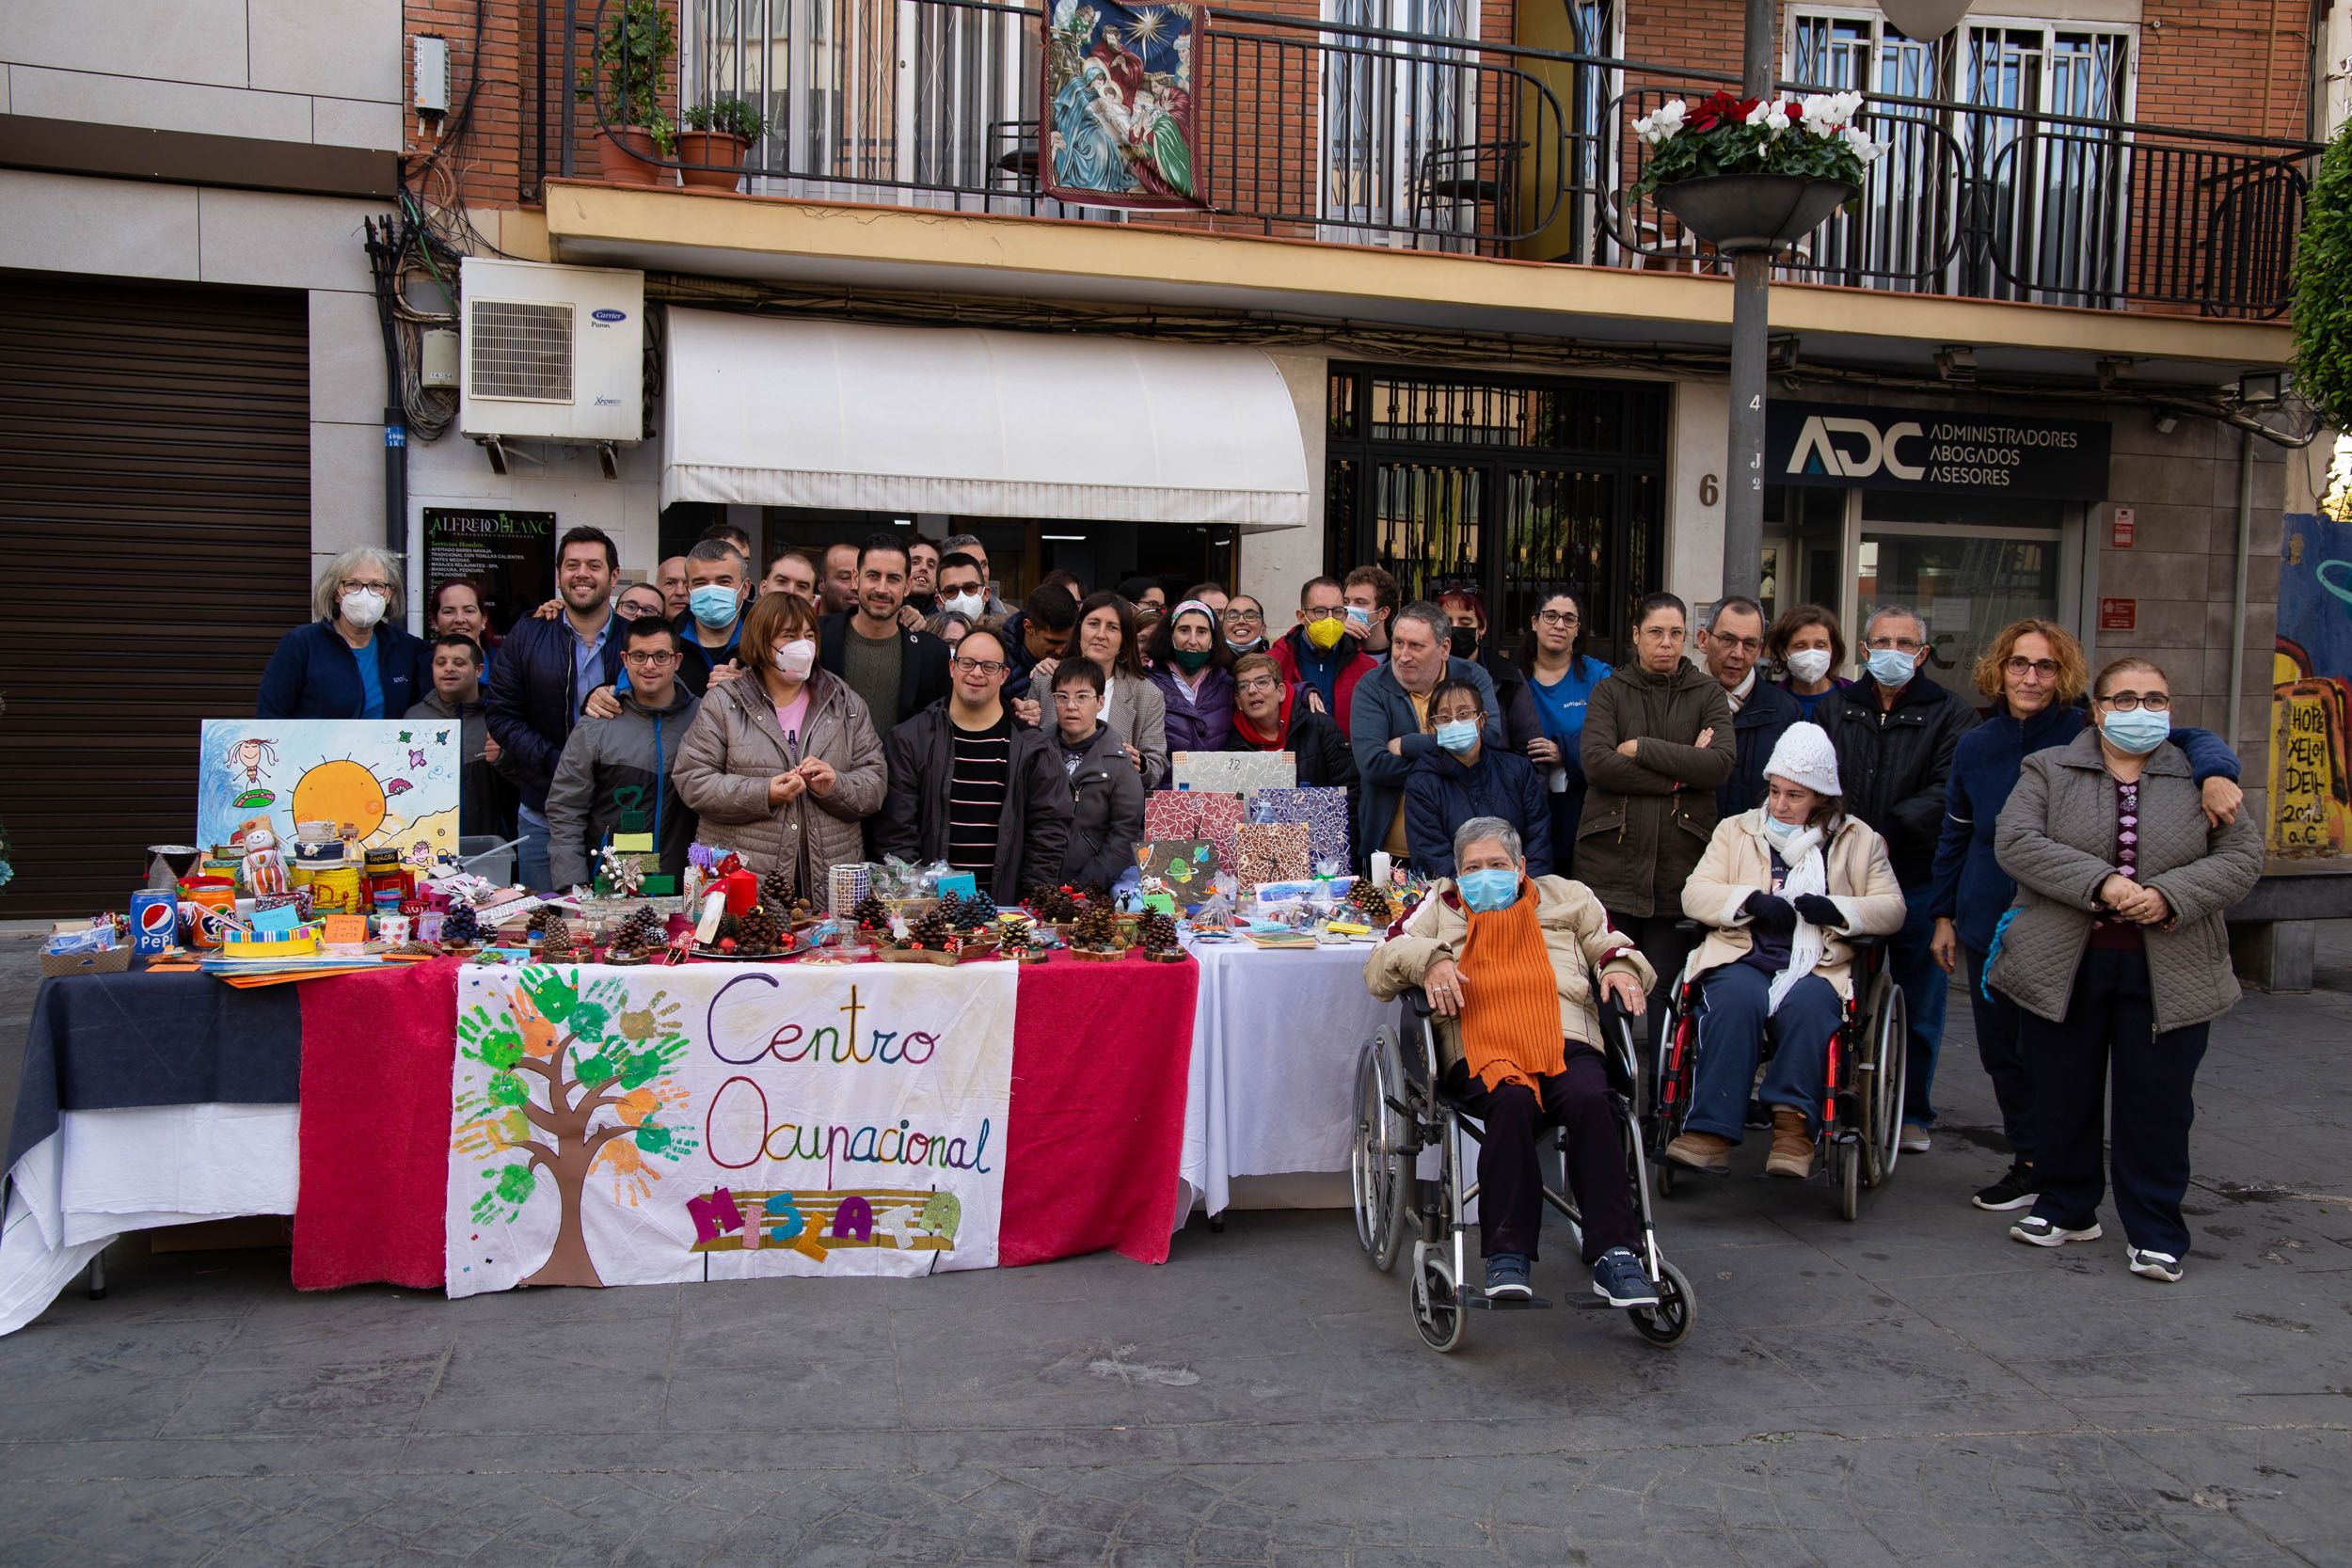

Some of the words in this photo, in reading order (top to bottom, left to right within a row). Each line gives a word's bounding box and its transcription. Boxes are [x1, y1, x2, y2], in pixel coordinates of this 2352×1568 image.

[595, 311, 623, 322] Carrier
[1749, 394, 1762, 412] 4
[1930, 422, 2078, 449] ADMINISTRADORES
[1786, 415, 1927, 482] ADC
[1930, 444, 2021, 467] ABOGADOS
[1752, 476, 1761, 492] 2
[1930, 466, 2010, 487] ASESORES
[1699, 472, 1719, 507] 6
[432, 516, 499, 533] ALFREDO
[707, 972, 941, 1066] Centro
[706, 1075, 991, 1191] Ocupacional
[685, 1186, 962, 1263] MISLATA
